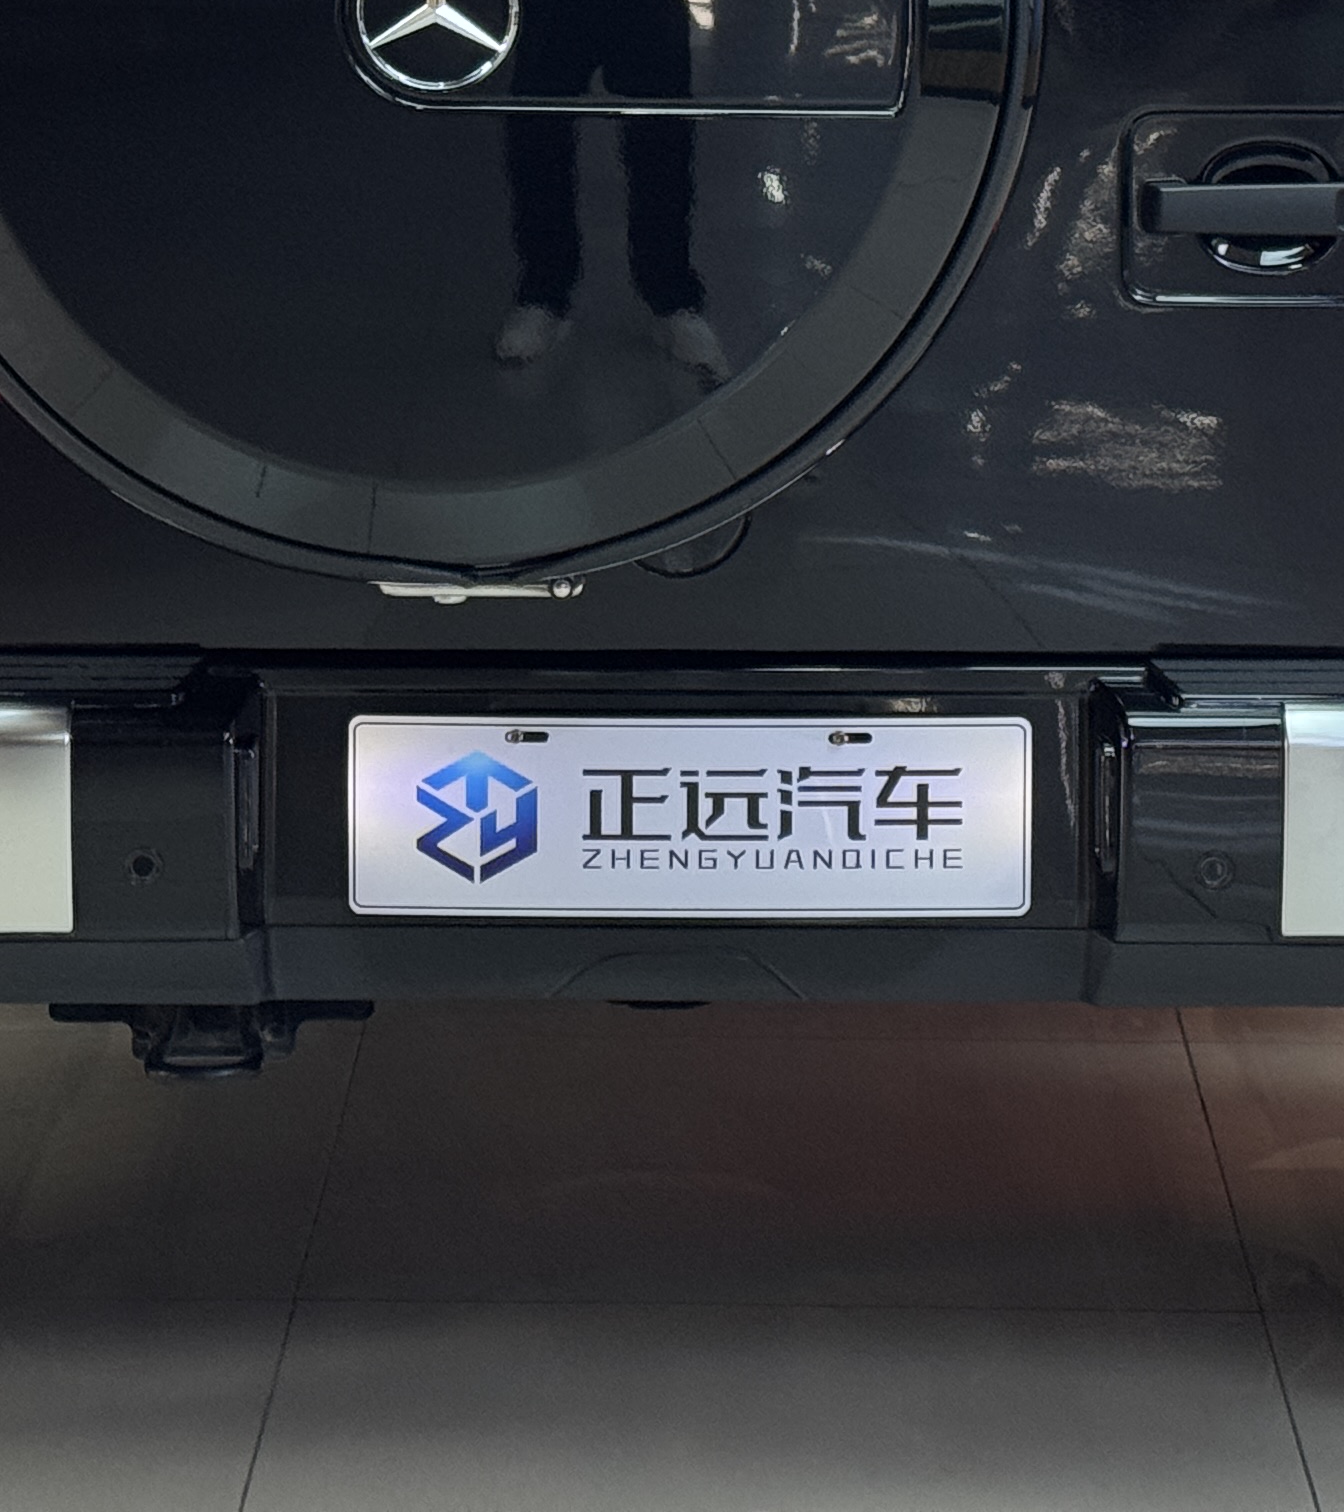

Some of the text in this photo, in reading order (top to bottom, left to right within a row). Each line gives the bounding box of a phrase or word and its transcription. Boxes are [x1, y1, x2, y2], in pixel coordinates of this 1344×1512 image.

[582, 766, 963, 841] 正远汽车
[582, 848, 963, 870] ZHENGYUANQICHE
